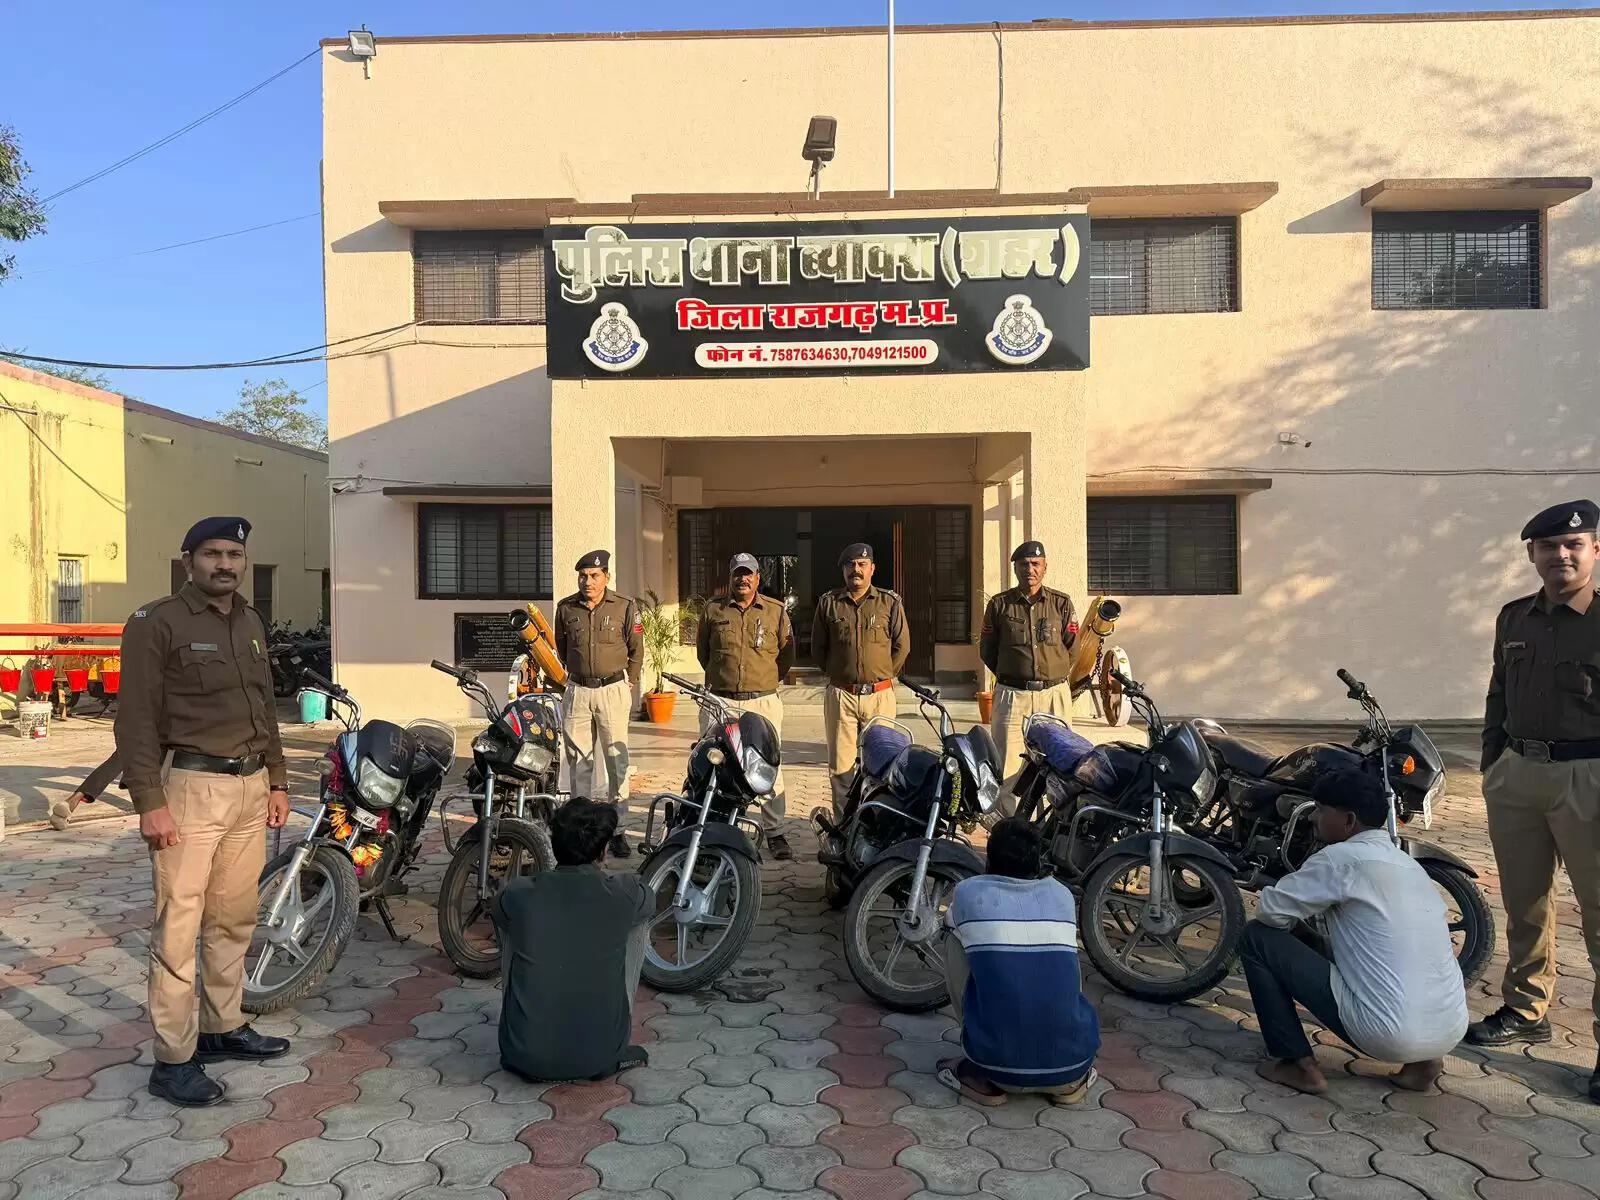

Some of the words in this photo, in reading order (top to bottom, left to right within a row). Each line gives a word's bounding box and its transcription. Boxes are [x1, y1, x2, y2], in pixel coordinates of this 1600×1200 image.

[552, 225, 687, 303] पुलिस
[689, 237, 795, 286] थाना
[676, 298, 767, 330] जिला
[767, 301, 877, 334] राजगढ़
[706, 346, 744, 363] फोन
[748, 344, 768, 362] नं.
